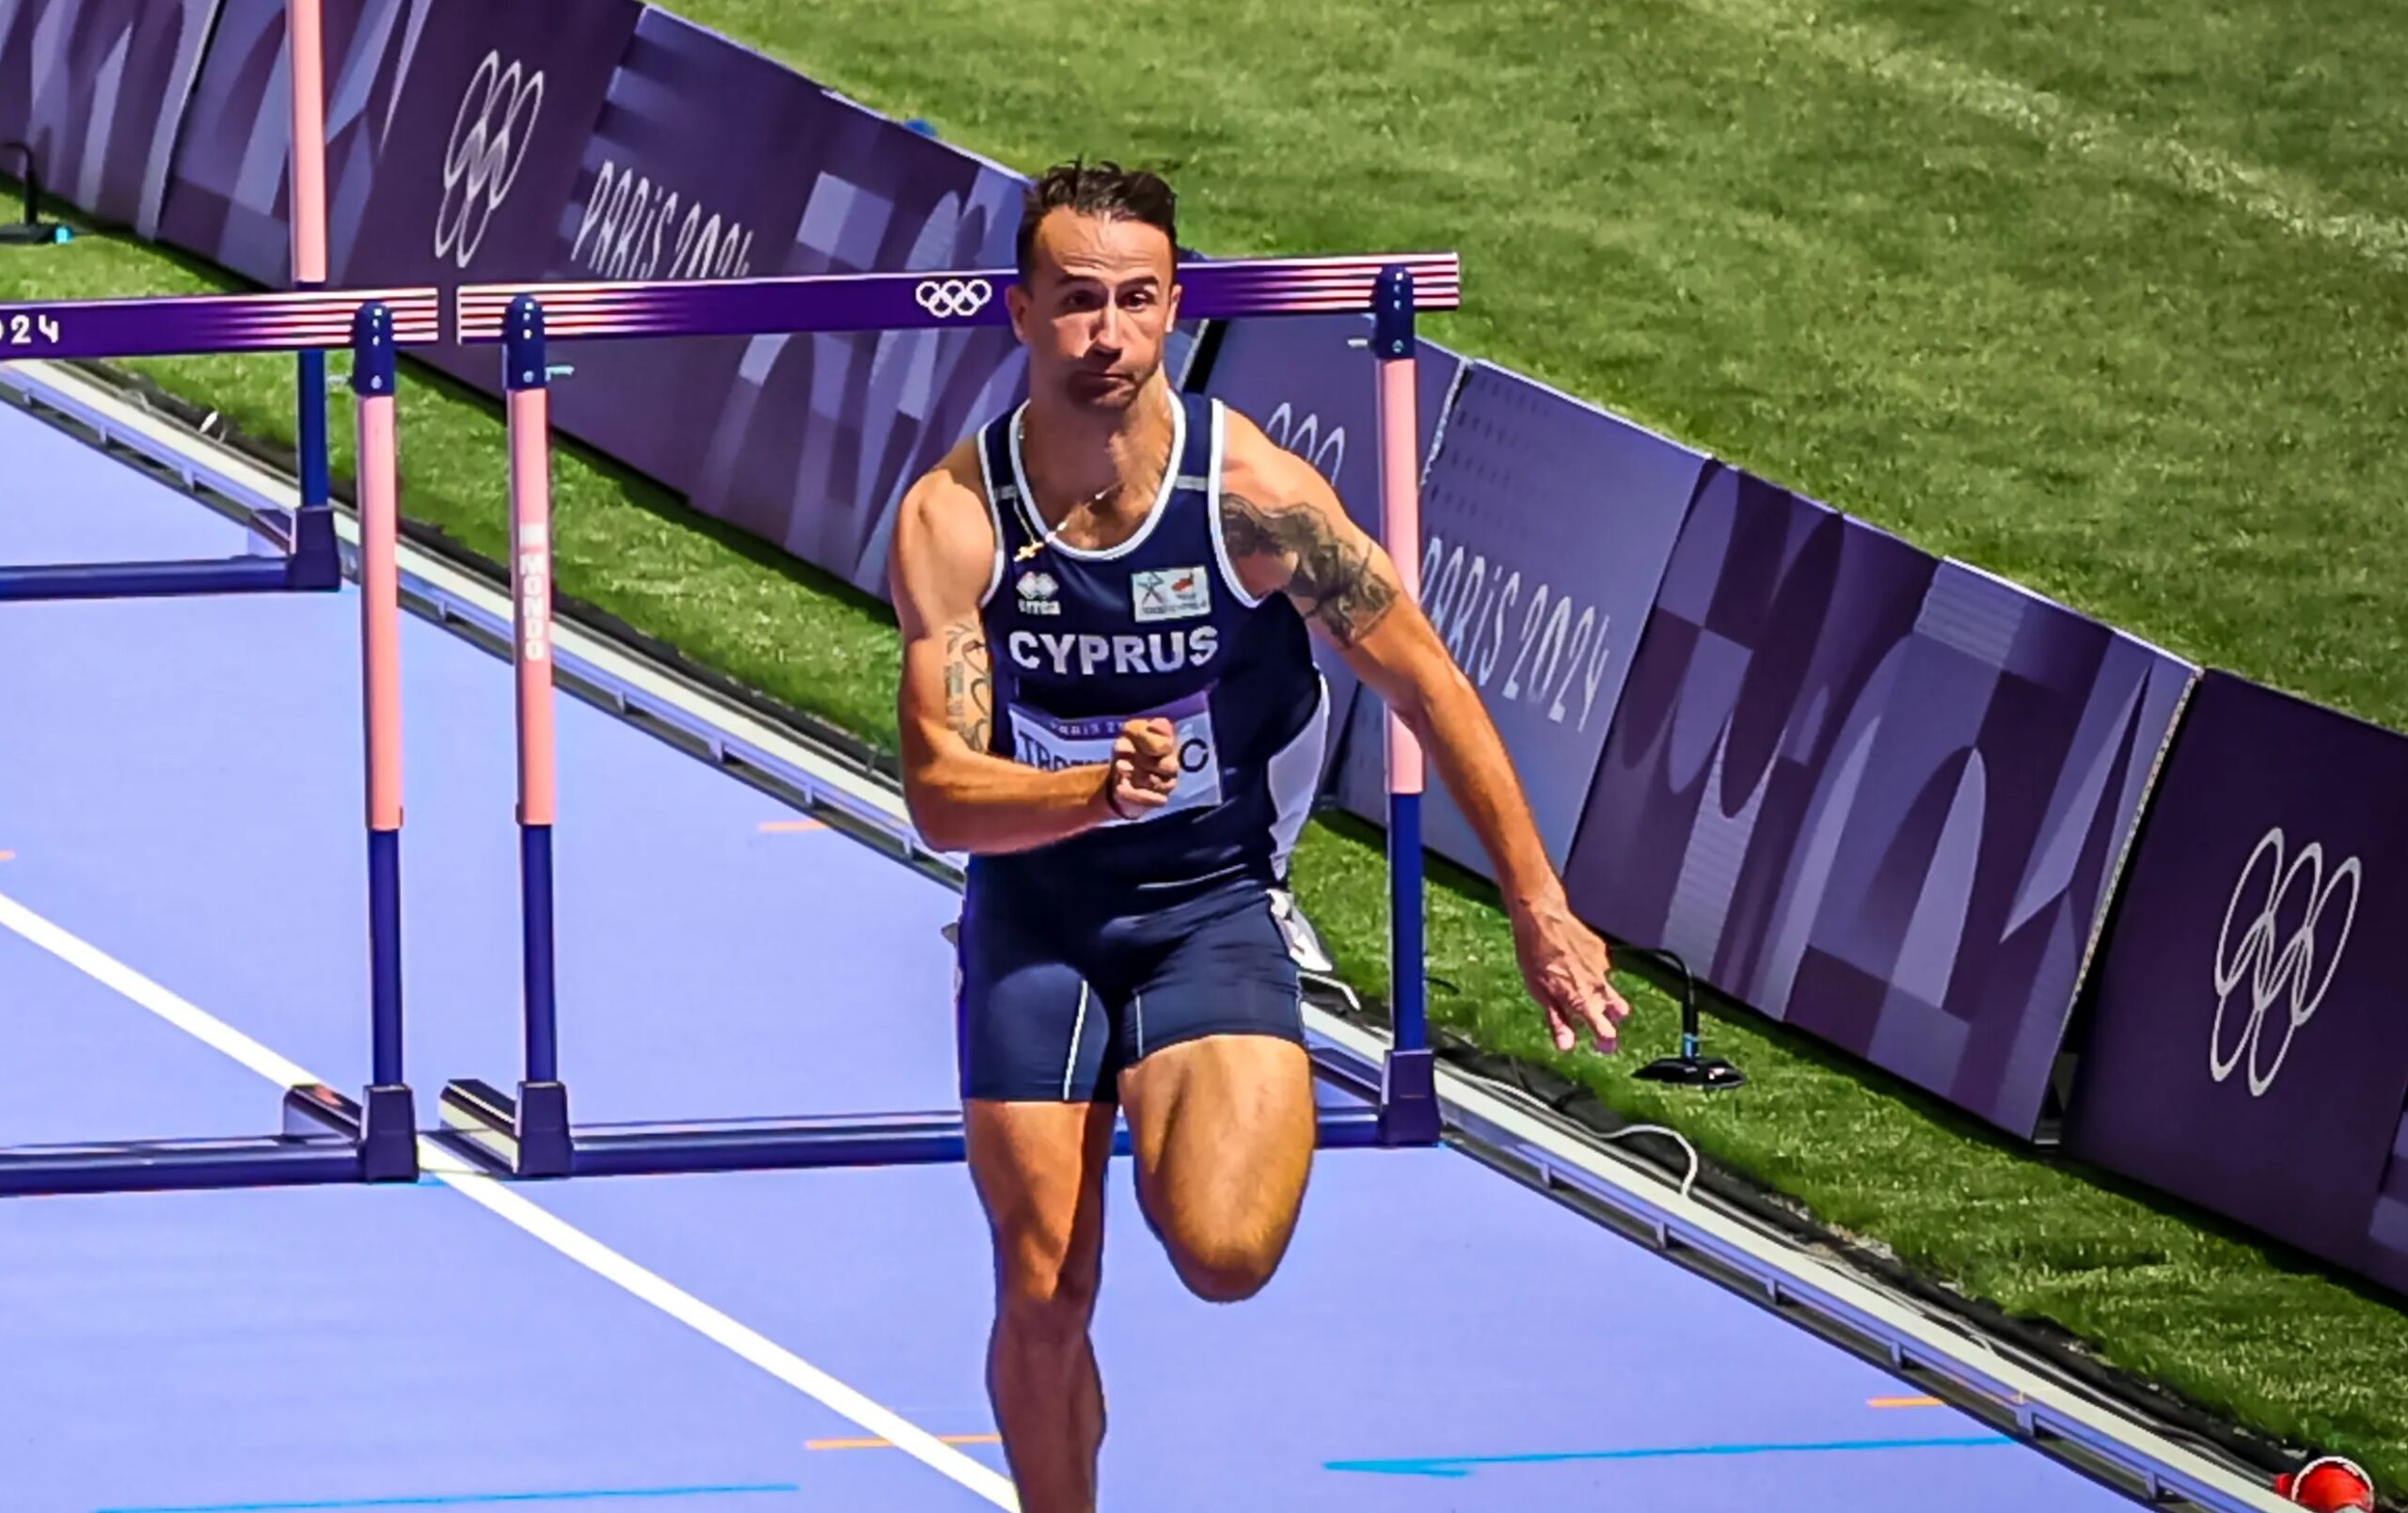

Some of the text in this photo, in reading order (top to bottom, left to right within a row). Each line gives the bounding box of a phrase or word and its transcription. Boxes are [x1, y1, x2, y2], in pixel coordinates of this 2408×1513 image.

[0, 314, 59, 344] 24
[1008, 625, 1218, 675] CYPRUS
[1502, 583, 1609, 733] 2024
